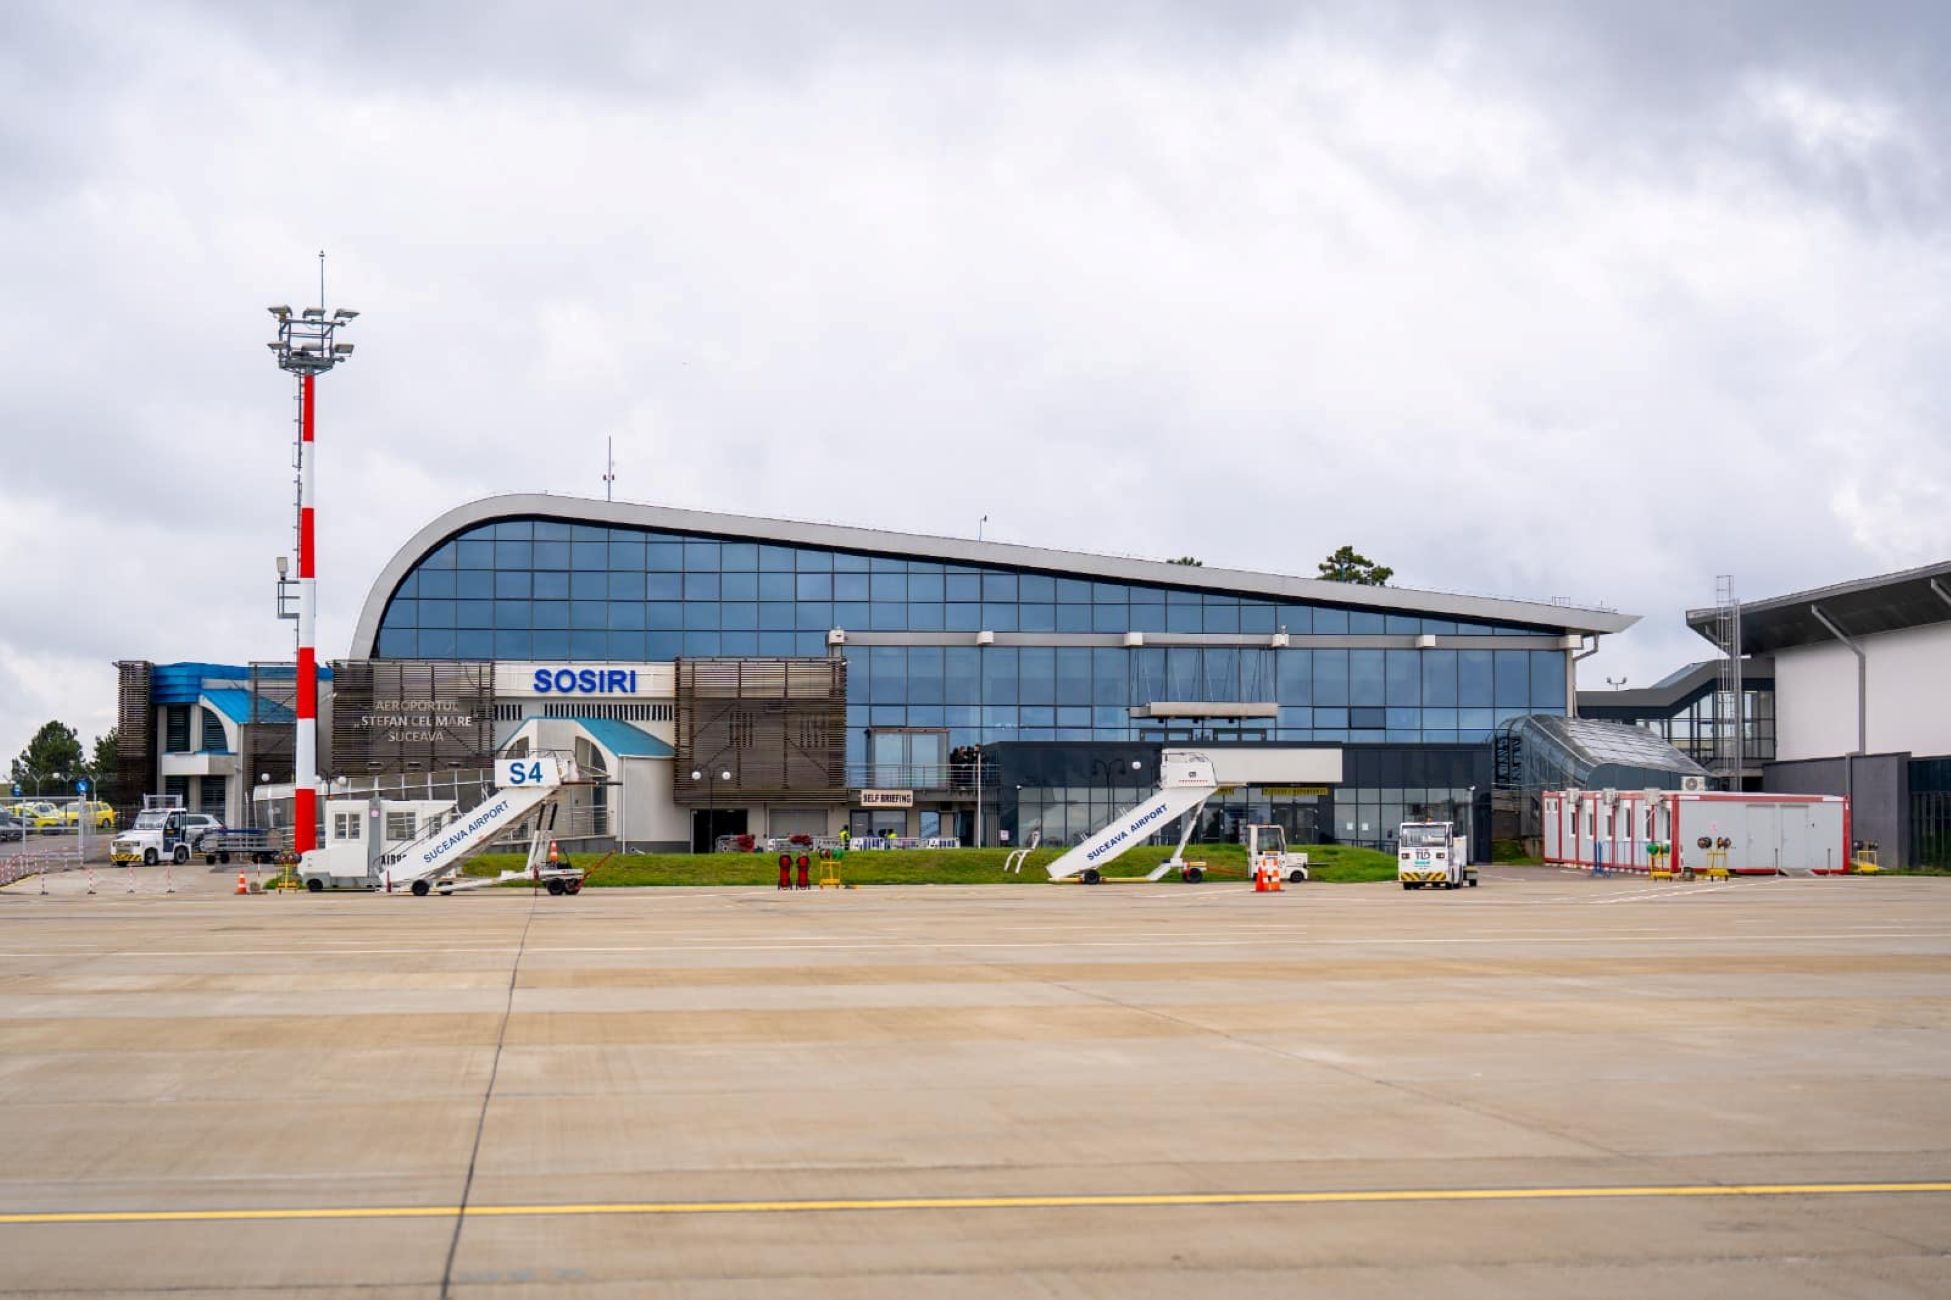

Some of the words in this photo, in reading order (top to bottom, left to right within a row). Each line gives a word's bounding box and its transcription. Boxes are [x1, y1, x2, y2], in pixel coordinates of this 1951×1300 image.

[533, 669, 636, 693] SOSIRI
[375, 700, 459, 712] AEROPORTUL
[411, 716, 432, 726] CEL
[388, 731, 444, 742] SUCEAVA
[509, 761, 543, 785] S4
[423, 830, 469, 863] SUCEAVA
[469, 800, 510, 834] AIRPORT
[1086, 831, 1128, 861] SUCEAVA
[1130, 803, 1168, 832] AIRPORT
